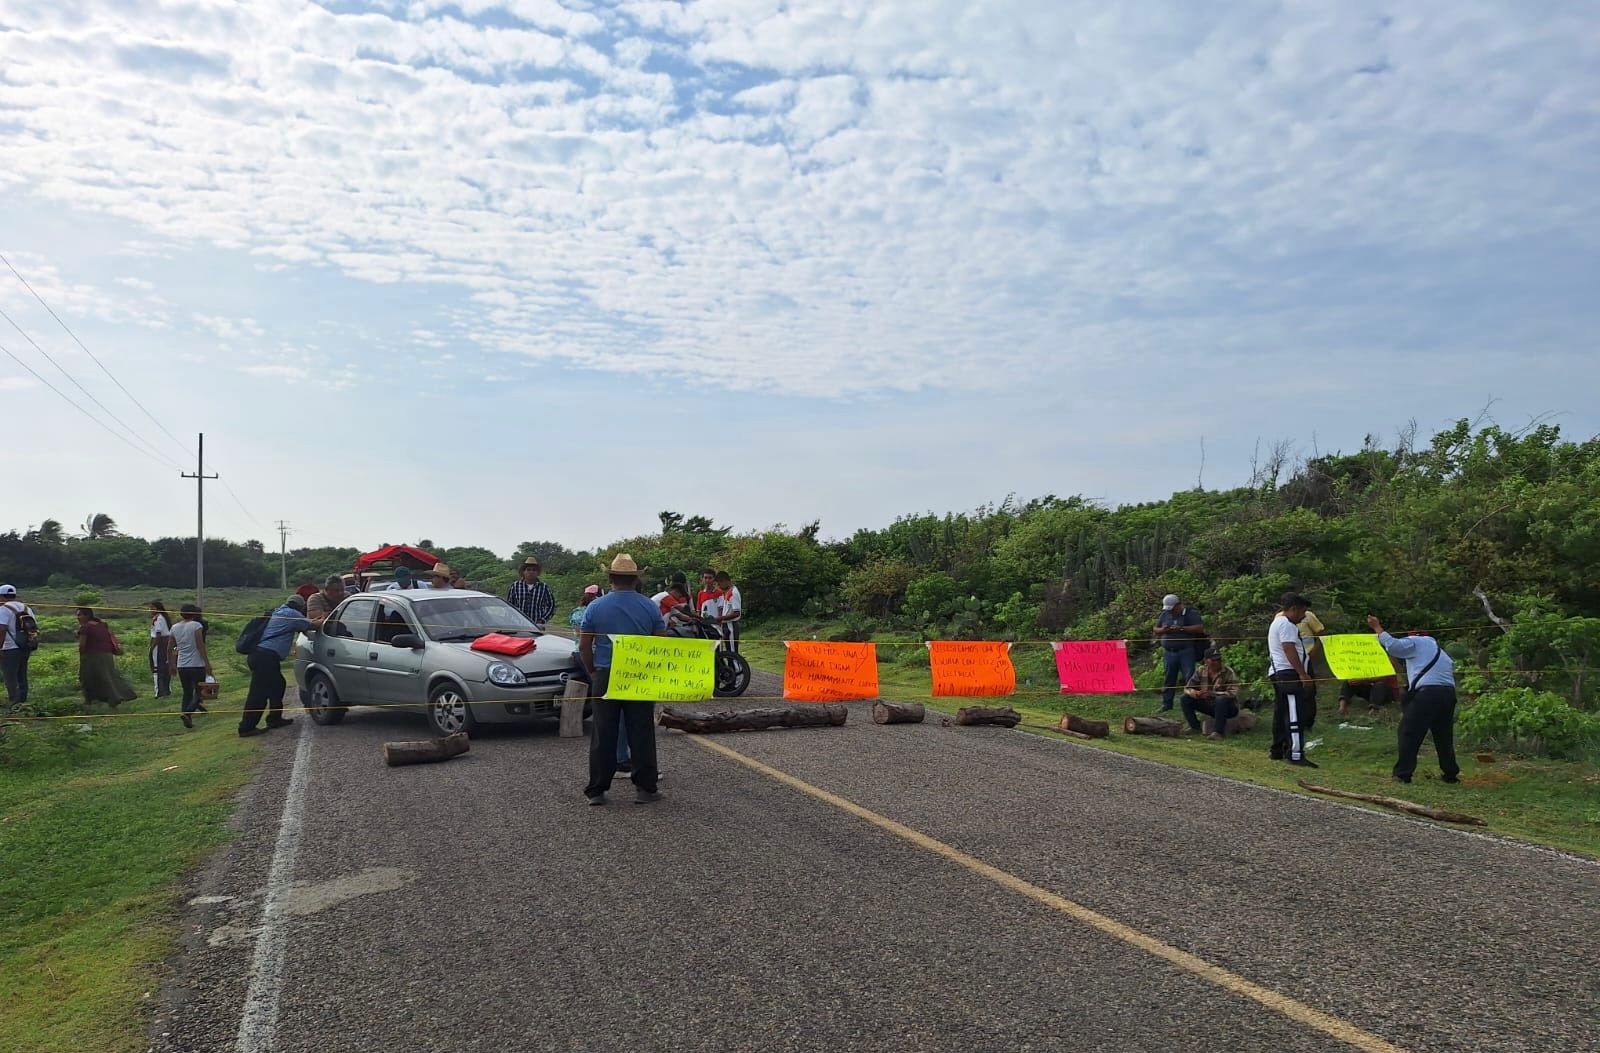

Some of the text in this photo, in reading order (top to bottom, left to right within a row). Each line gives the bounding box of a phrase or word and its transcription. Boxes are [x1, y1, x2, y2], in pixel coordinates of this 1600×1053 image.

[645, 645, 671, 656] GANAS
[673, 648, 685, 658] DE
[687, 650, 703, 659] VER
[842, 649, 859, 659] UNA
[667, 661, 680, 672] DE
[684, 663, 695, 673] LO
[1085, 663, 1100, 673] LUZ
[669, 677, 680, 686] MI
[615, 683, 631, 692] SIN
